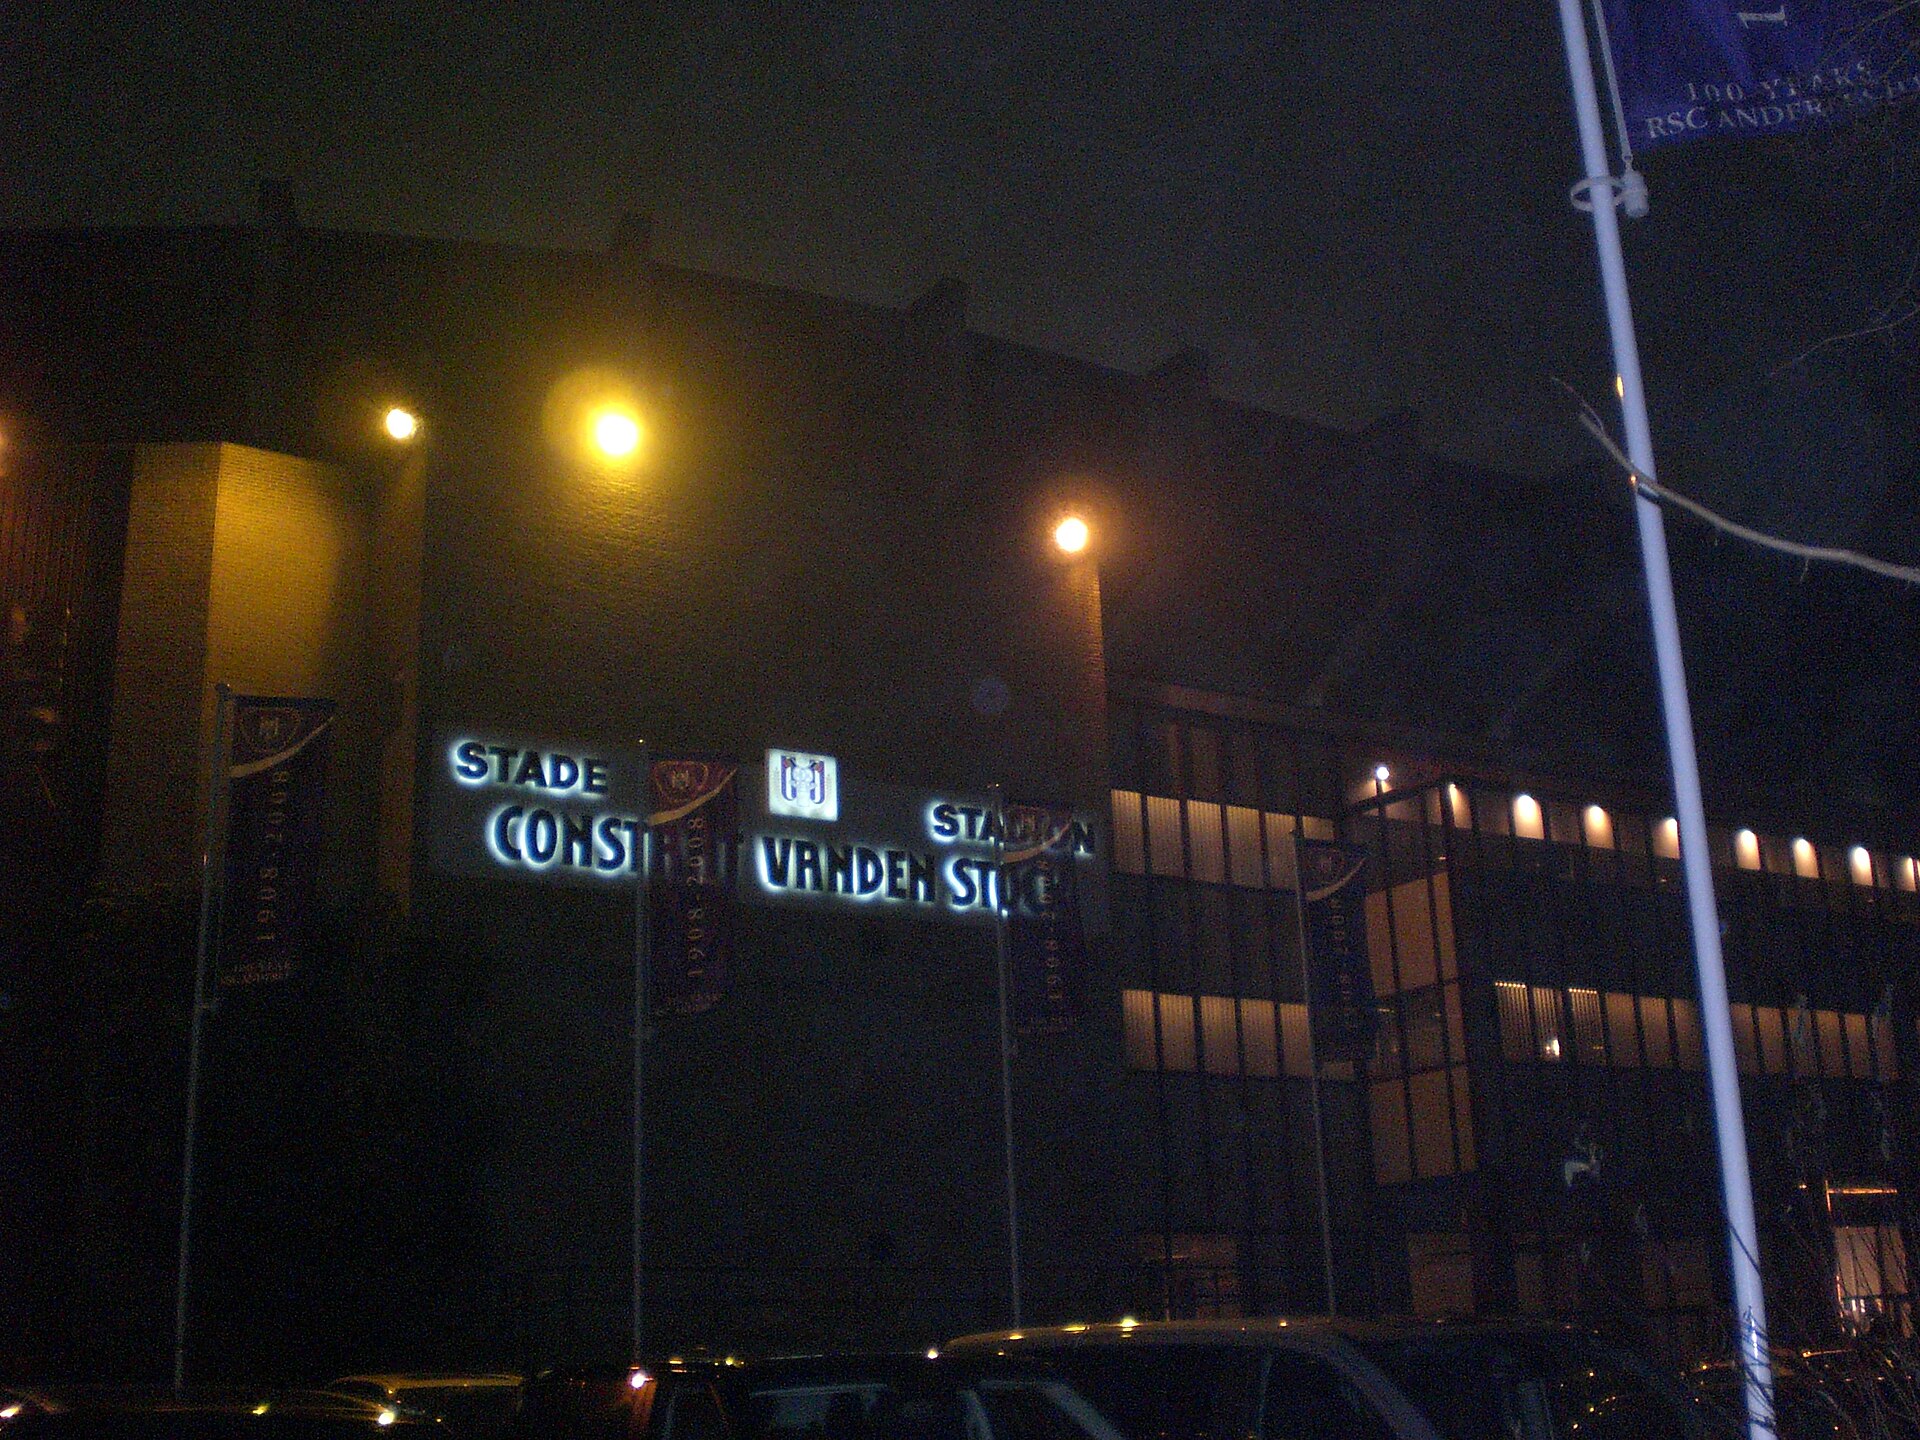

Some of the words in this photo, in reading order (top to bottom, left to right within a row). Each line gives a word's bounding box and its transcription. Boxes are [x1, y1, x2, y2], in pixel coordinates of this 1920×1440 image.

[1687, 82, 1744, 103] 100
[1646, 106, 1709, 139] RSC
[455, 741, 609, 793] STADE
[932, 803, 1095, 853] STAN
[763, 836, 937, 902] VANDEN
[951, 857, 1070, 920] STOC
